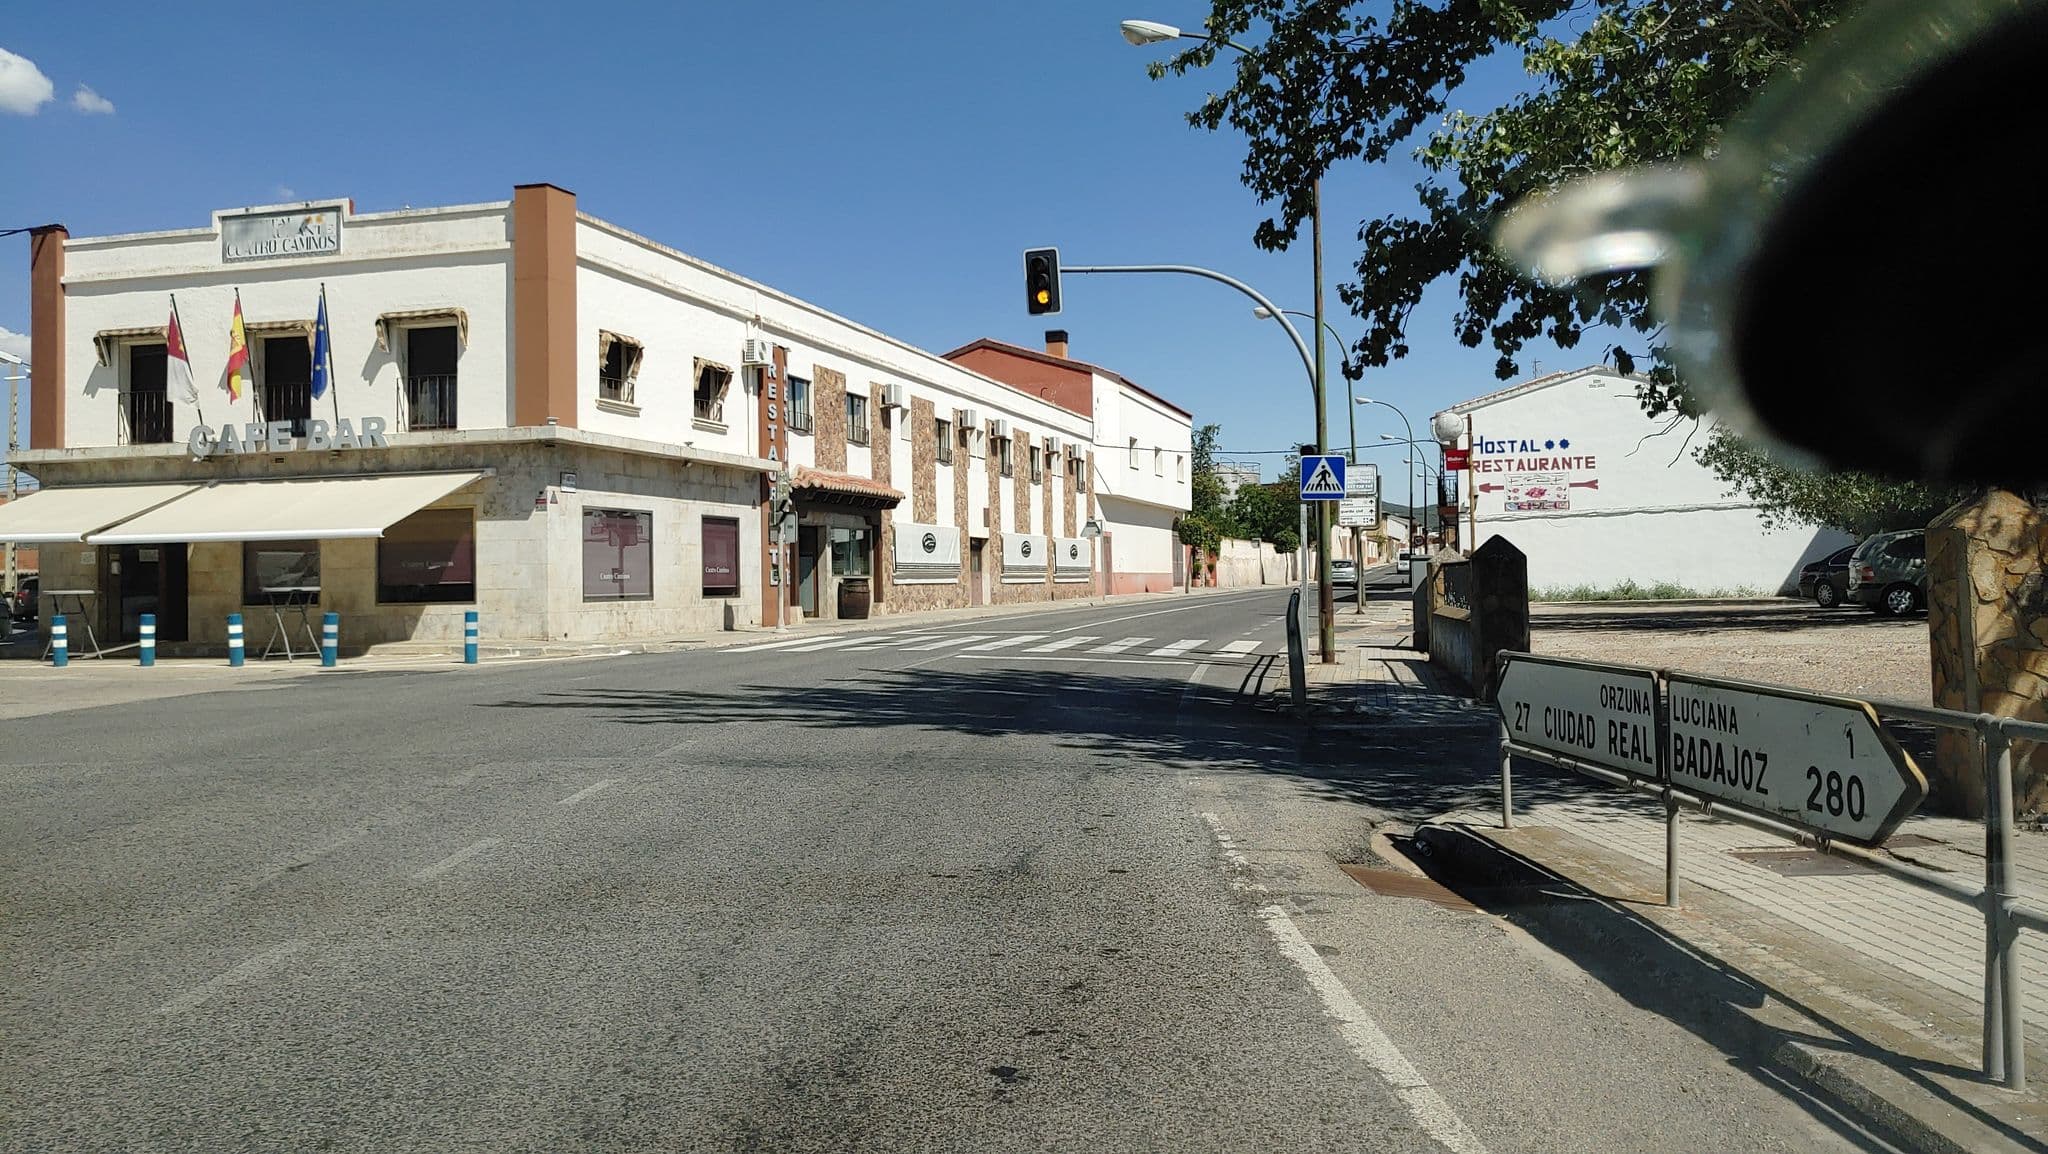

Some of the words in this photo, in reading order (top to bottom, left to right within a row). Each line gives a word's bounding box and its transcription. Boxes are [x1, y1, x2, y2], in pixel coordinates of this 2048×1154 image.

[282, 235, 336, 252] CAMINOS
[189, 419, 293, 458] CAFE
[306, 416, 390, 451] BAR
[1472, 435, 1541, 455] HOSTAL
[1472, 455, 1596, 473] RESTAURANTE
[1600, 684, 1651, 716] ORZUNA
[1515, 701, 1530, 733] 27
[1544, 706, 1596, 749] CIUDAD
[1608, 719, 1653, 765] REAL
[1673, 694, 1738, 735] LUCIANA
[1846, 727, 1855, 759] 1
[1673, 732, 1769, 795] BADAJOZ
[1806, 765, 1865, 822] 280
